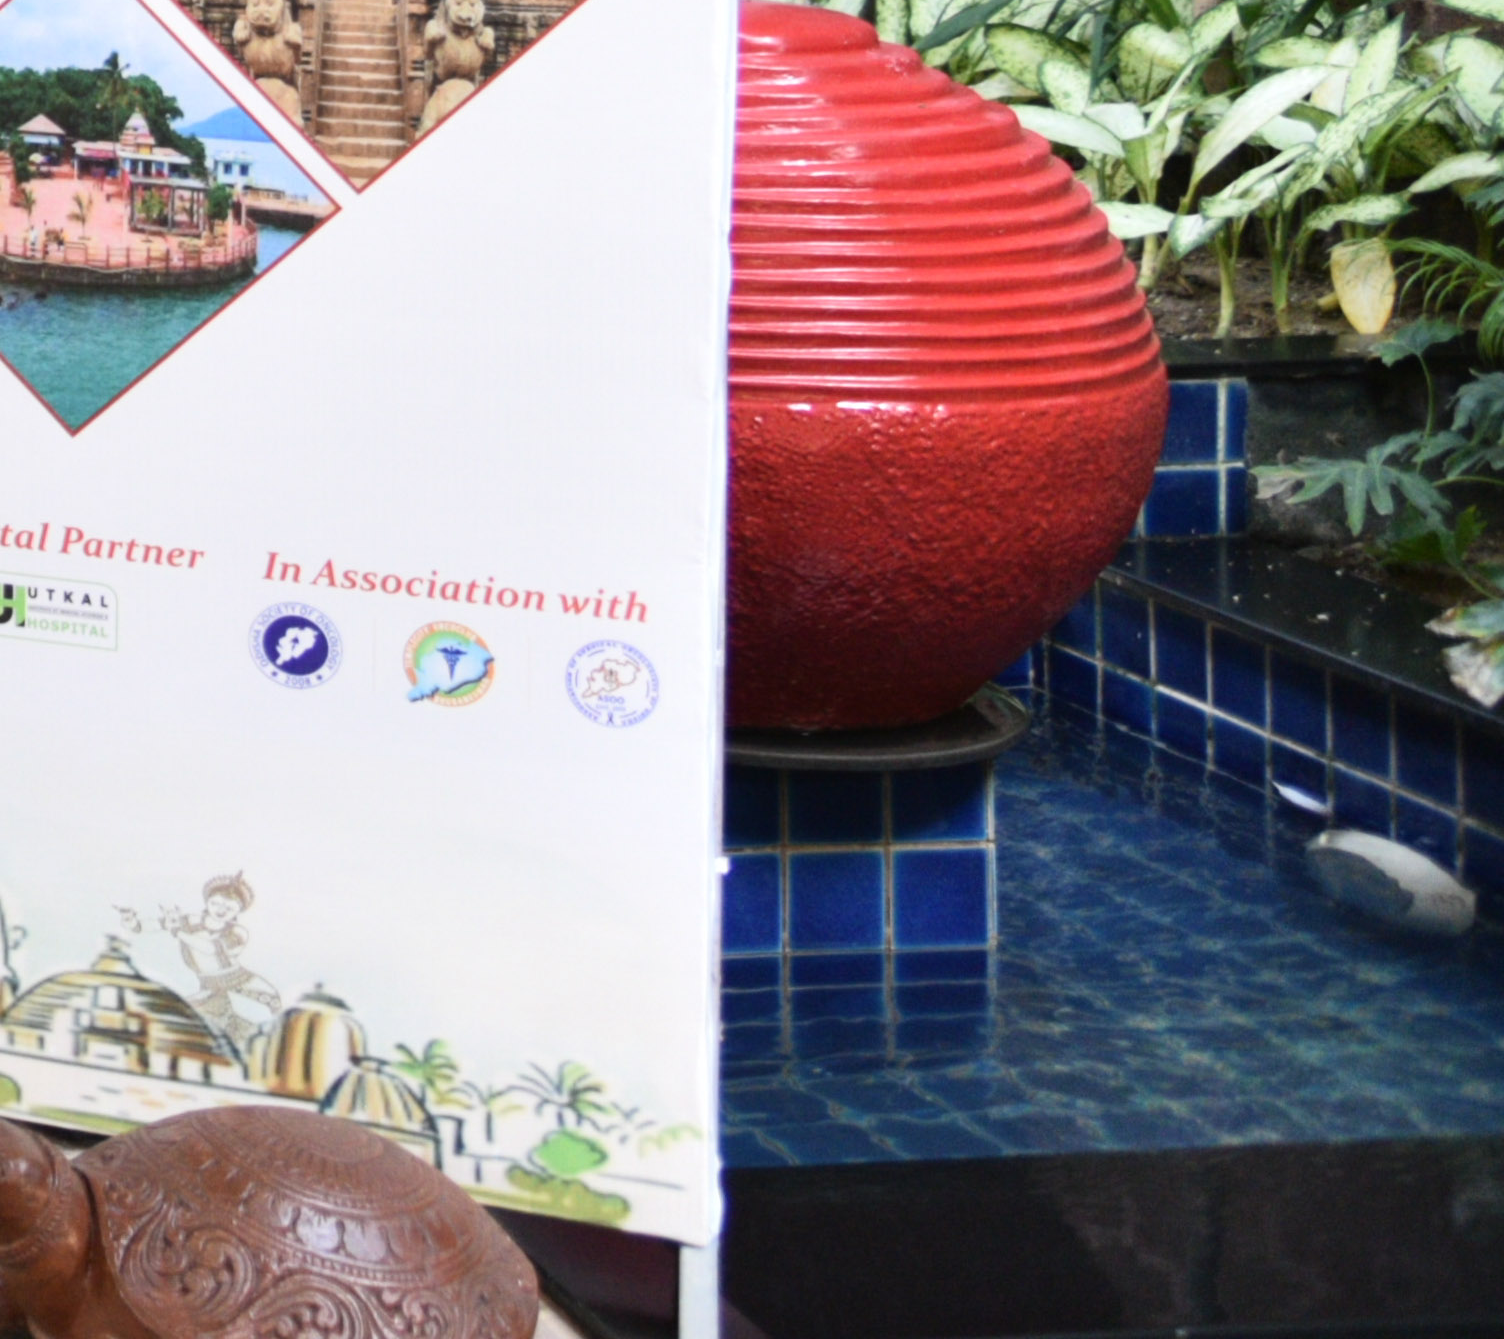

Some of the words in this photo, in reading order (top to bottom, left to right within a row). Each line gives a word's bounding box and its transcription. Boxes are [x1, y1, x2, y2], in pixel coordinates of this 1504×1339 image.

[60, 527, 204, 568] Partner
[28, 587, 107, 608] UTKAL
[264, 552, 300, 583] In
[312, 559, 544, 611] Association
[560, 589, 646, 622] with
[28, 619, 107, 638] HOSPITAL
